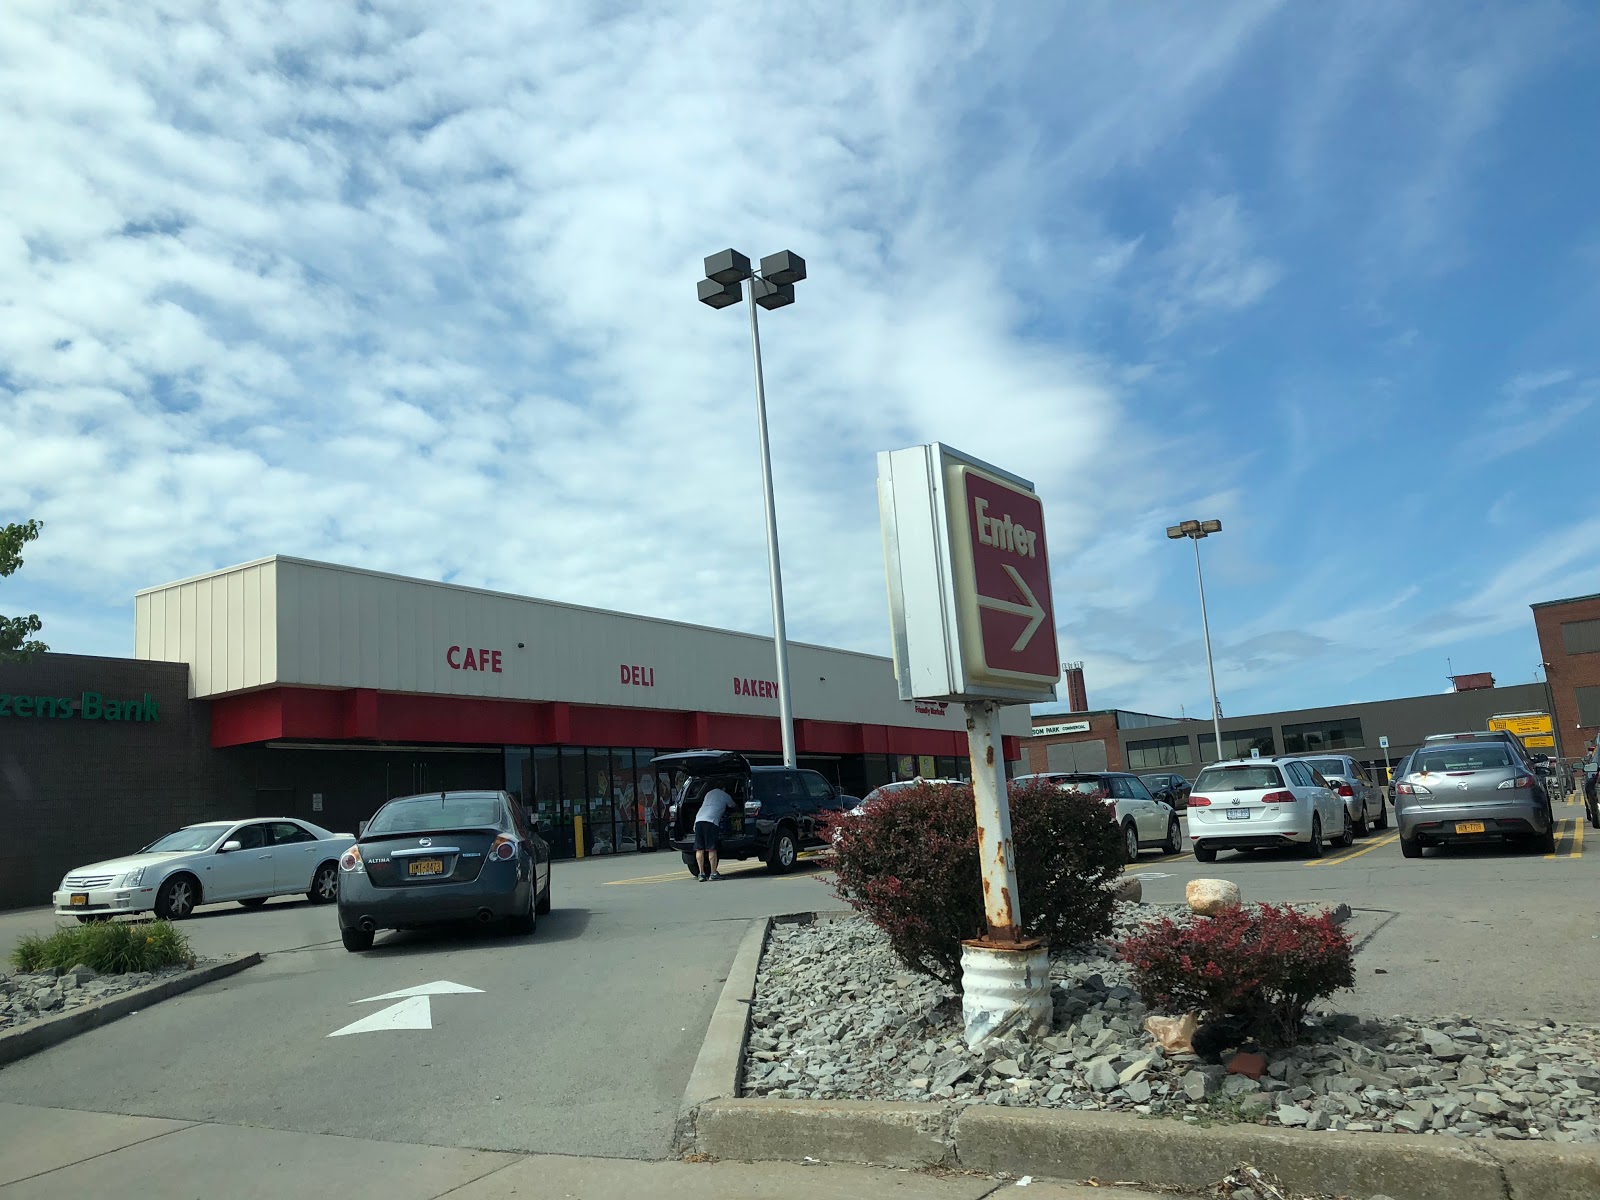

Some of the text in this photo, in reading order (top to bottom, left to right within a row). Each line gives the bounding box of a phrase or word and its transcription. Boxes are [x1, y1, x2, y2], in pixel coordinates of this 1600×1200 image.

[974, 496, 1037, 559] Enter
[447, 645, 502, 673] CAFE
[620, 664, 655, 688] DELI
[733, 677, 779, 699] BAKERY
[81, 691, 161, 722] Bank
[1045, 726, 1060, 734] PARK
